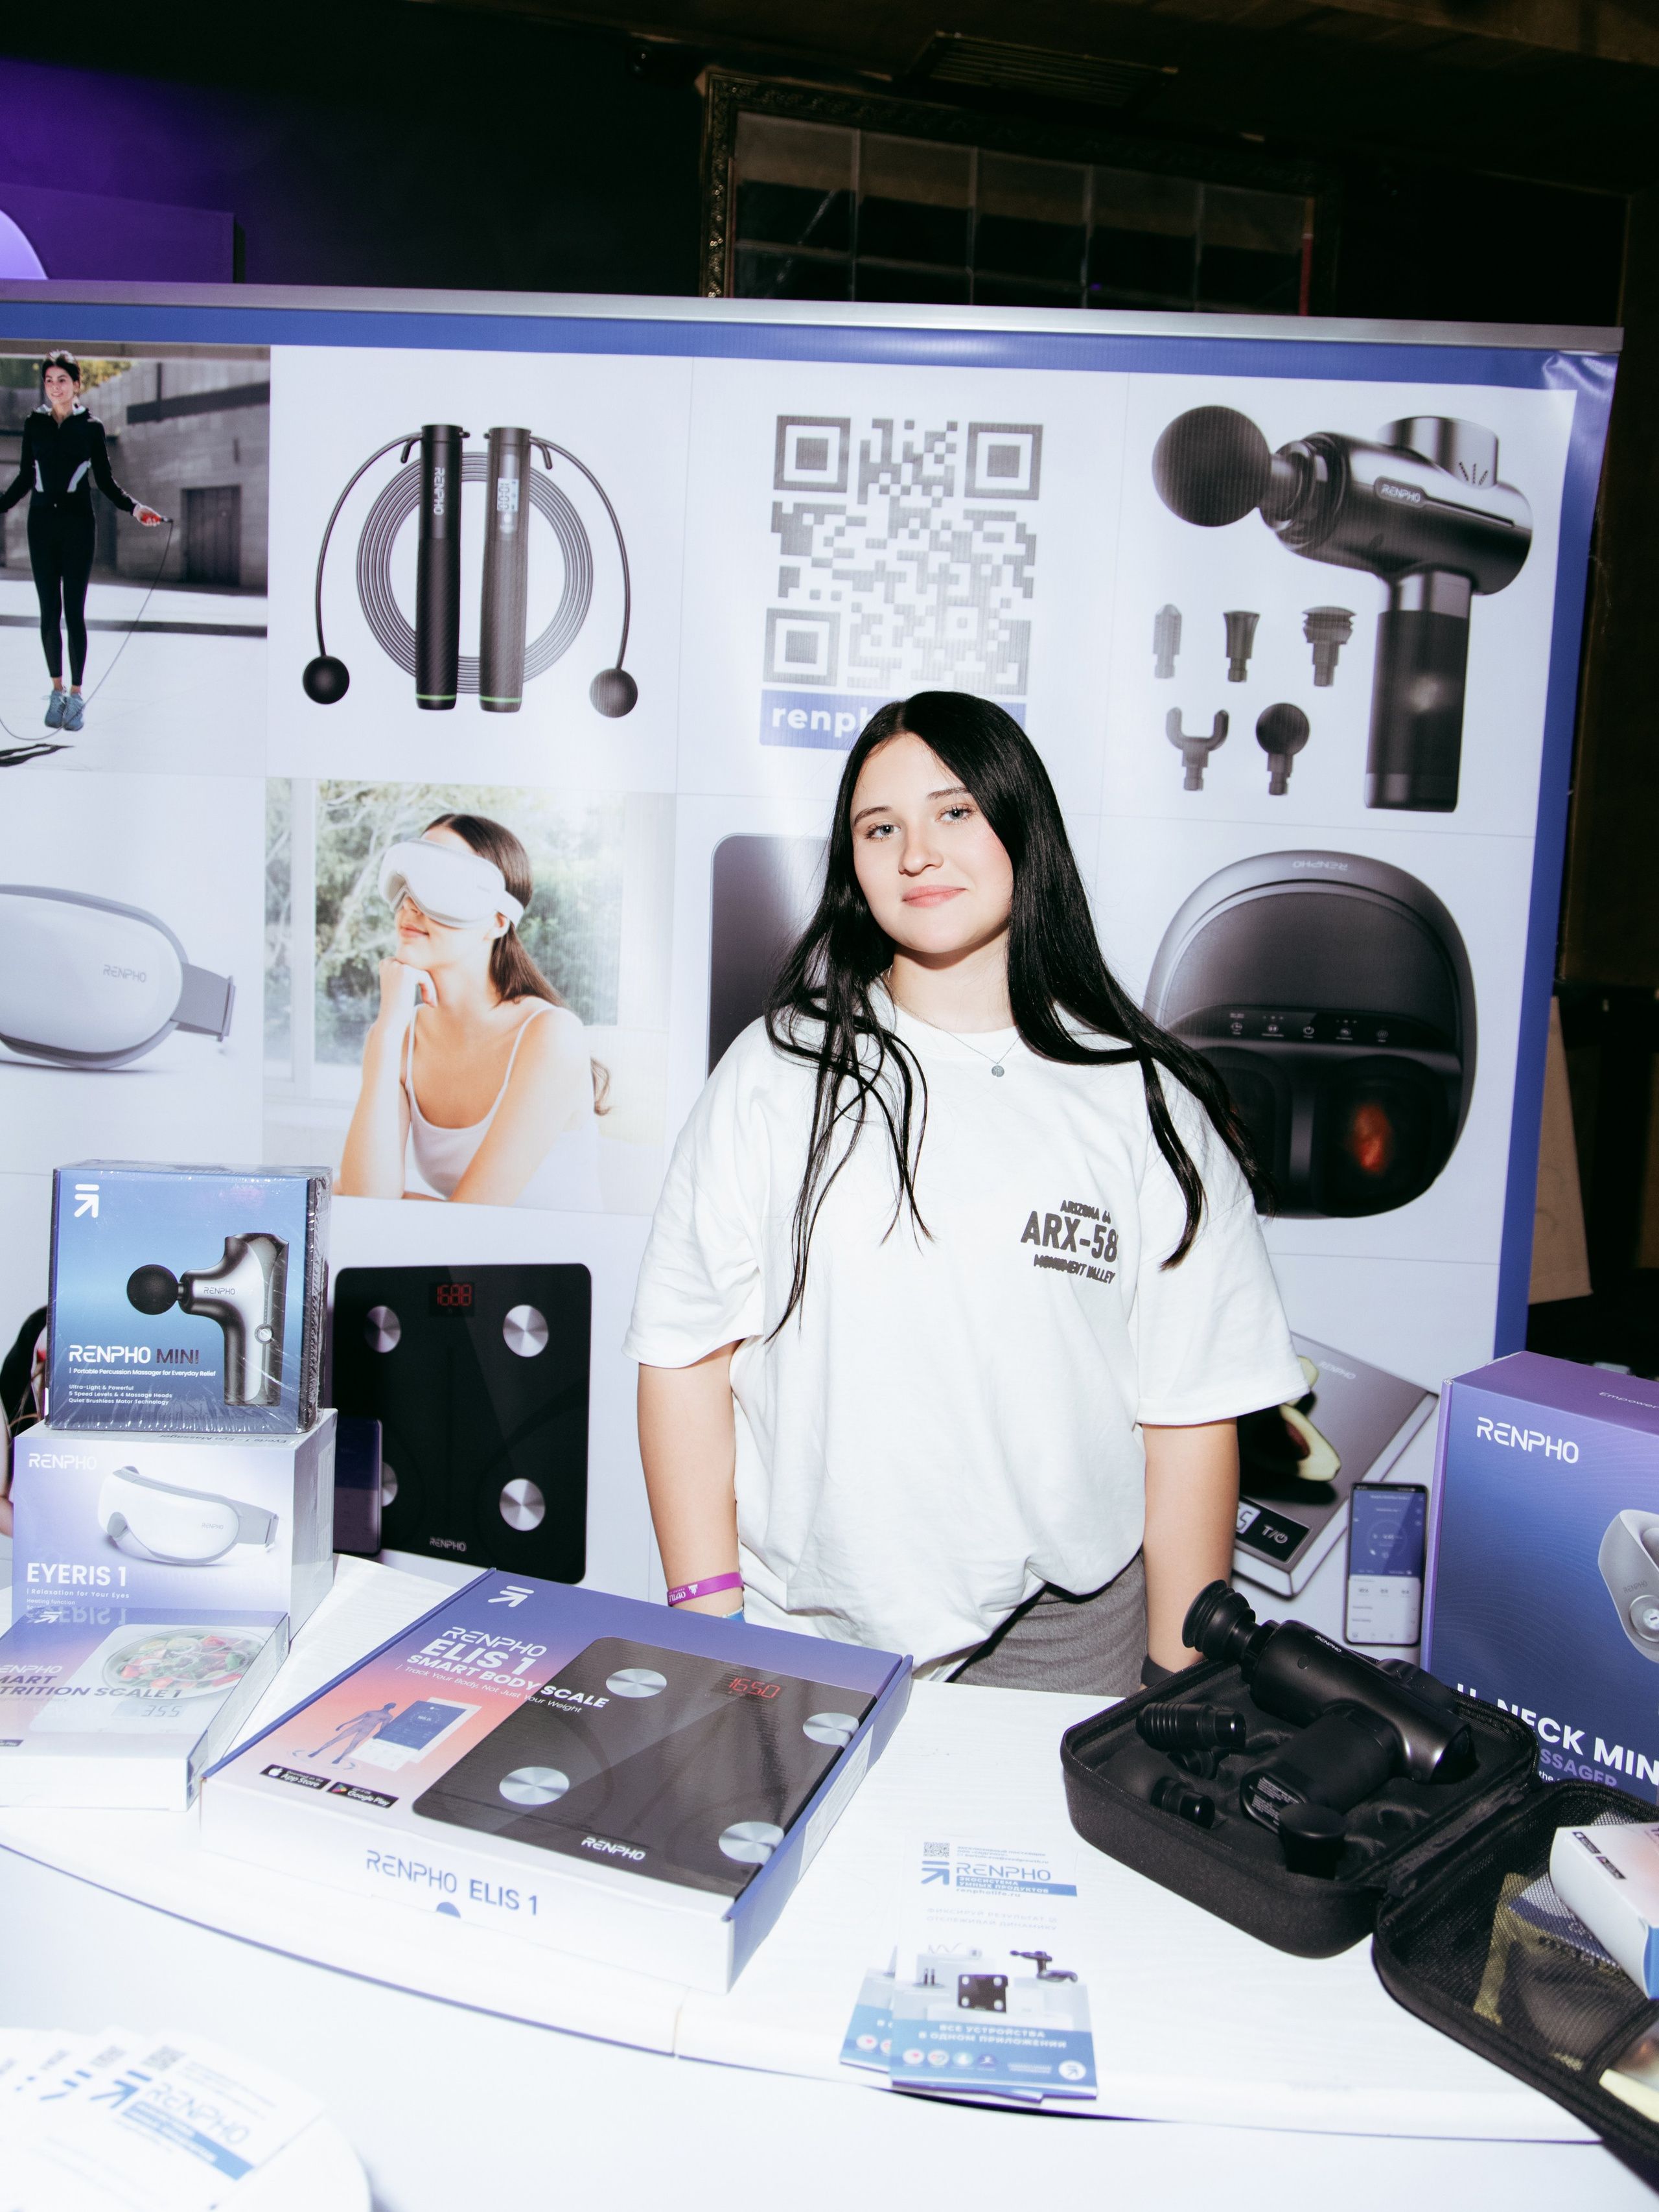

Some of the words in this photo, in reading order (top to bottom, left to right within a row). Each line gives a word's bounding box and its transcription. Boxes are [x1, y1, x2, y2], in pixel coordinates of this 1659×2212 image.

[434, 467, 446, 516] RENPHO
[1380, 484, 1421, 504] RENPHO
[772, 706, 874, 738] renph
[1292, 860, 1349, 872] RENPHO
[102, 964, 147, 983] RENPHO
[1020, 1211, 1119, 1263] ARX-58
[1086, 1265, 1115, 1284] VALLEY
[203, 1286, 236, 1296] RENPHO
[69, 1344, 151, 1364] RENPHO
[156, 1348, 199, 1364] MINI
[1318, 1361, 1356, 1380] RENPHO
[1476, 1416, 1579, 1464] RENPHO
[28, 1453, 97, 1471] RENPHO
[201, 1522, 224, 1531] RENPHO
[429, 1537, 467, 1552] RENPHO
[27, 1563, 111, 1586] EYERIS
[118, 1566, 126, 1587] 1
[1622, 1579, 1648, 1594] RENPHO
[442, 1627, 547, 1657] RENPHO
[1314, 1634, 1342, 1653] RENPHO
[419, 1638, 509, 1670] ELIS
[511, 1657, 537, 1675] 1
[0, 1664, 63, 1673] ENPHO
[0, 1675, 58, 1684] MART
[406, 1655, 481, 1677] SMART
[483, 1671, 542, 1691] BODY
[540, 1685, 610, 1708] SCALE
[728, 1677, 780, 1699] 1650
[0, 1686, 91, 1696] TRITION
[93, 1688, 168, 1698] SCALE
[172, 1690, 183, 1698] 1
[405, 1666, 430, 1677] Track
[432, 1673, 454, 1683] Your
[454, 1678, 480, 1690] Body,
[481, 1684, 500, 1694] Not
[500, 1690, 521, 1699] Just
[524, 1693, 546, 1705] Your
[547, 1700, 583, 1714] Weight
[141, 1705, 183, 1717] 355
[1540, 1749, 1617, 1787] SSAGER
[281, 1773, 299, 1784] App
[298, 1778, 320, 1788] Store
[347, 1790, 375, 1802] Google
[373, 1795, 391, 1807] Play
[581, 1836, 645, 1861] RENPHO
[957, 1862, 1051, 1881] RENPHO
[959, 1876, 1019, 1886] ЭКОСИСТЕМА
[366, 1849, 458, 1893] RENPHO
[469, 1879, 520, 1910] ELIS
[528, 1895, 539, 1916] 1
[995, 1884, 1049, 1894] ПРОДУКТОВ
[957, 1888, 1021, 1898] renpholife.ru
[939, 2024, 963, 2032] ВСЕ
[966, 2025, 1045, 2038] УСТРОЙСТВА
